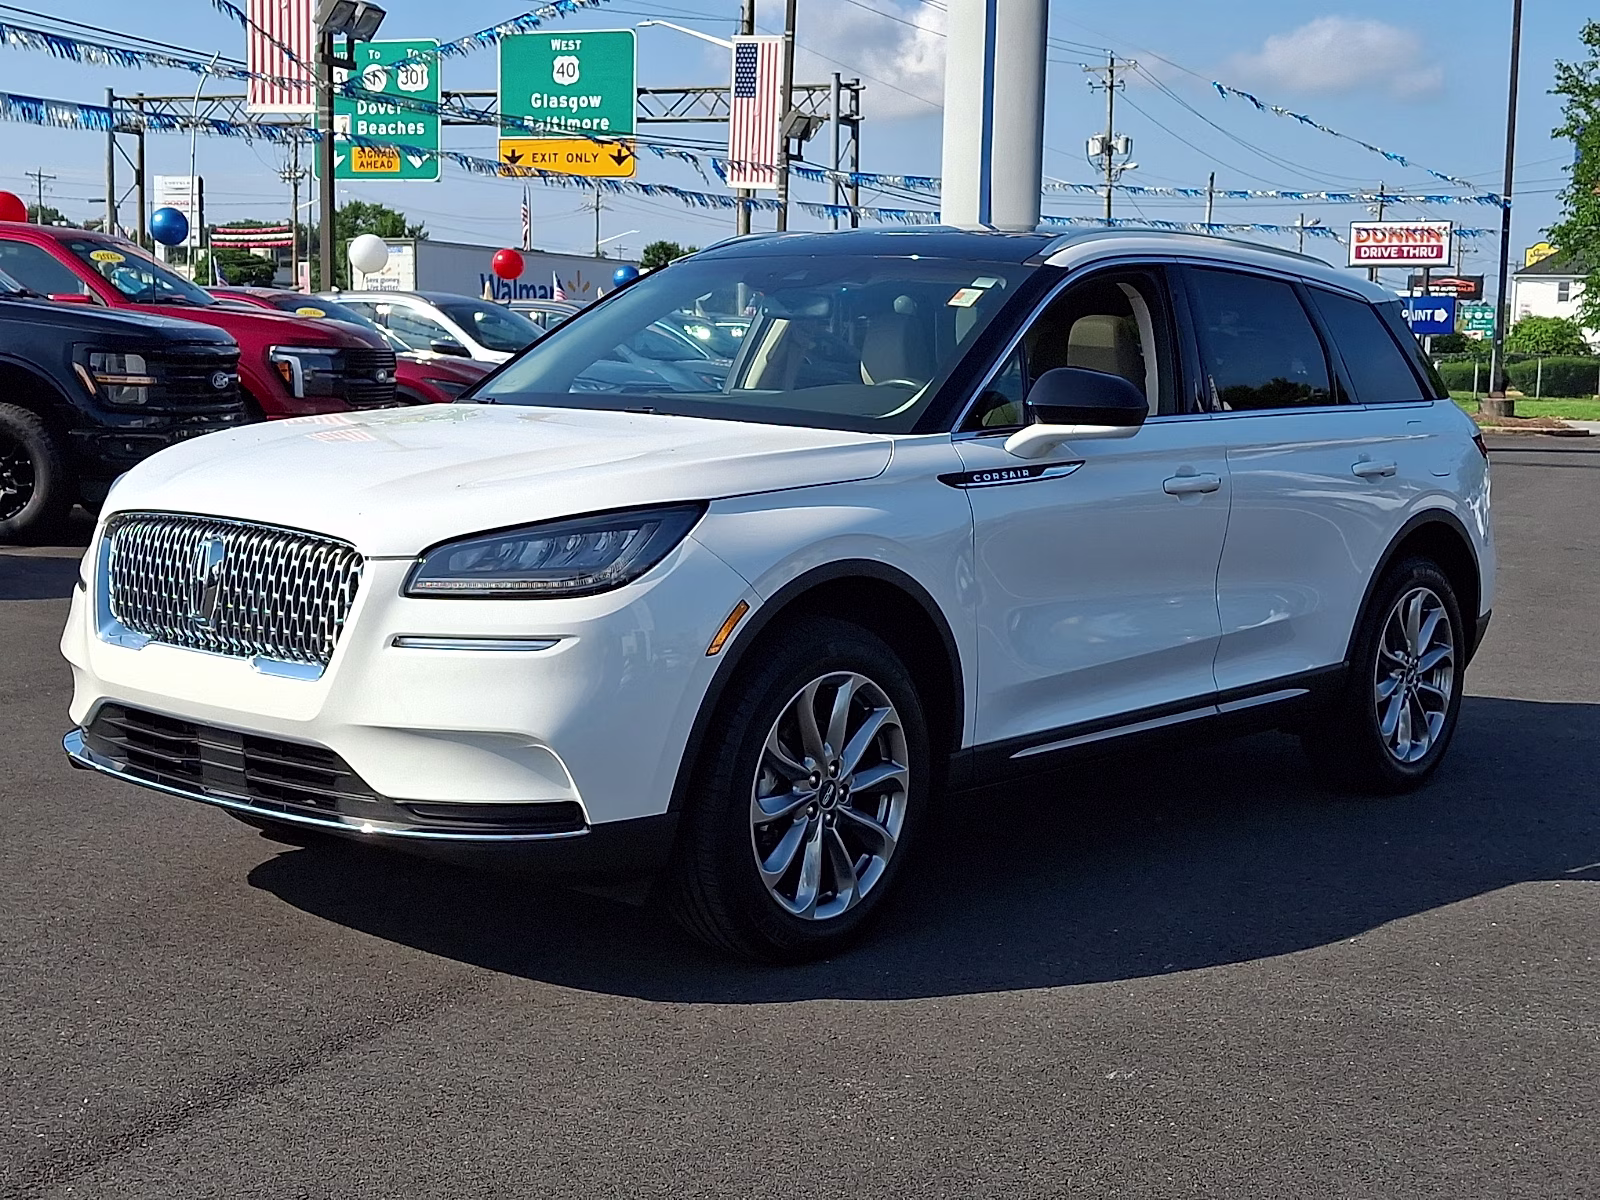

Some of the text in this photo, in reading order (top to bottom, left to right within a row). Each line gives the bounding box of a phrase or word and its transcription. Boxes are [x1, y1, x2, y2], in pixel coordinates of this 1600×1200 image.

[550, 39, 582, 50] WEST
[400, 69, 424, 85] 301
[556, 62, 576, 78] 40
[531, 92, 602, 113] Glasgow
[357, 120, 425, 135] Beaches
[523, 115, 610, 131] Baltimore
[357, 149, 395, 159] SIGNAL
[531, 153, 599, 163] EXIT ONLY
[359, 160, 393, 169] AHEAD
[1360, 246, 1438, 258] DRIVE THRU
[480, 273, 556, 300] Walmar
[973, 469, 1030, 482] CORSAIR
